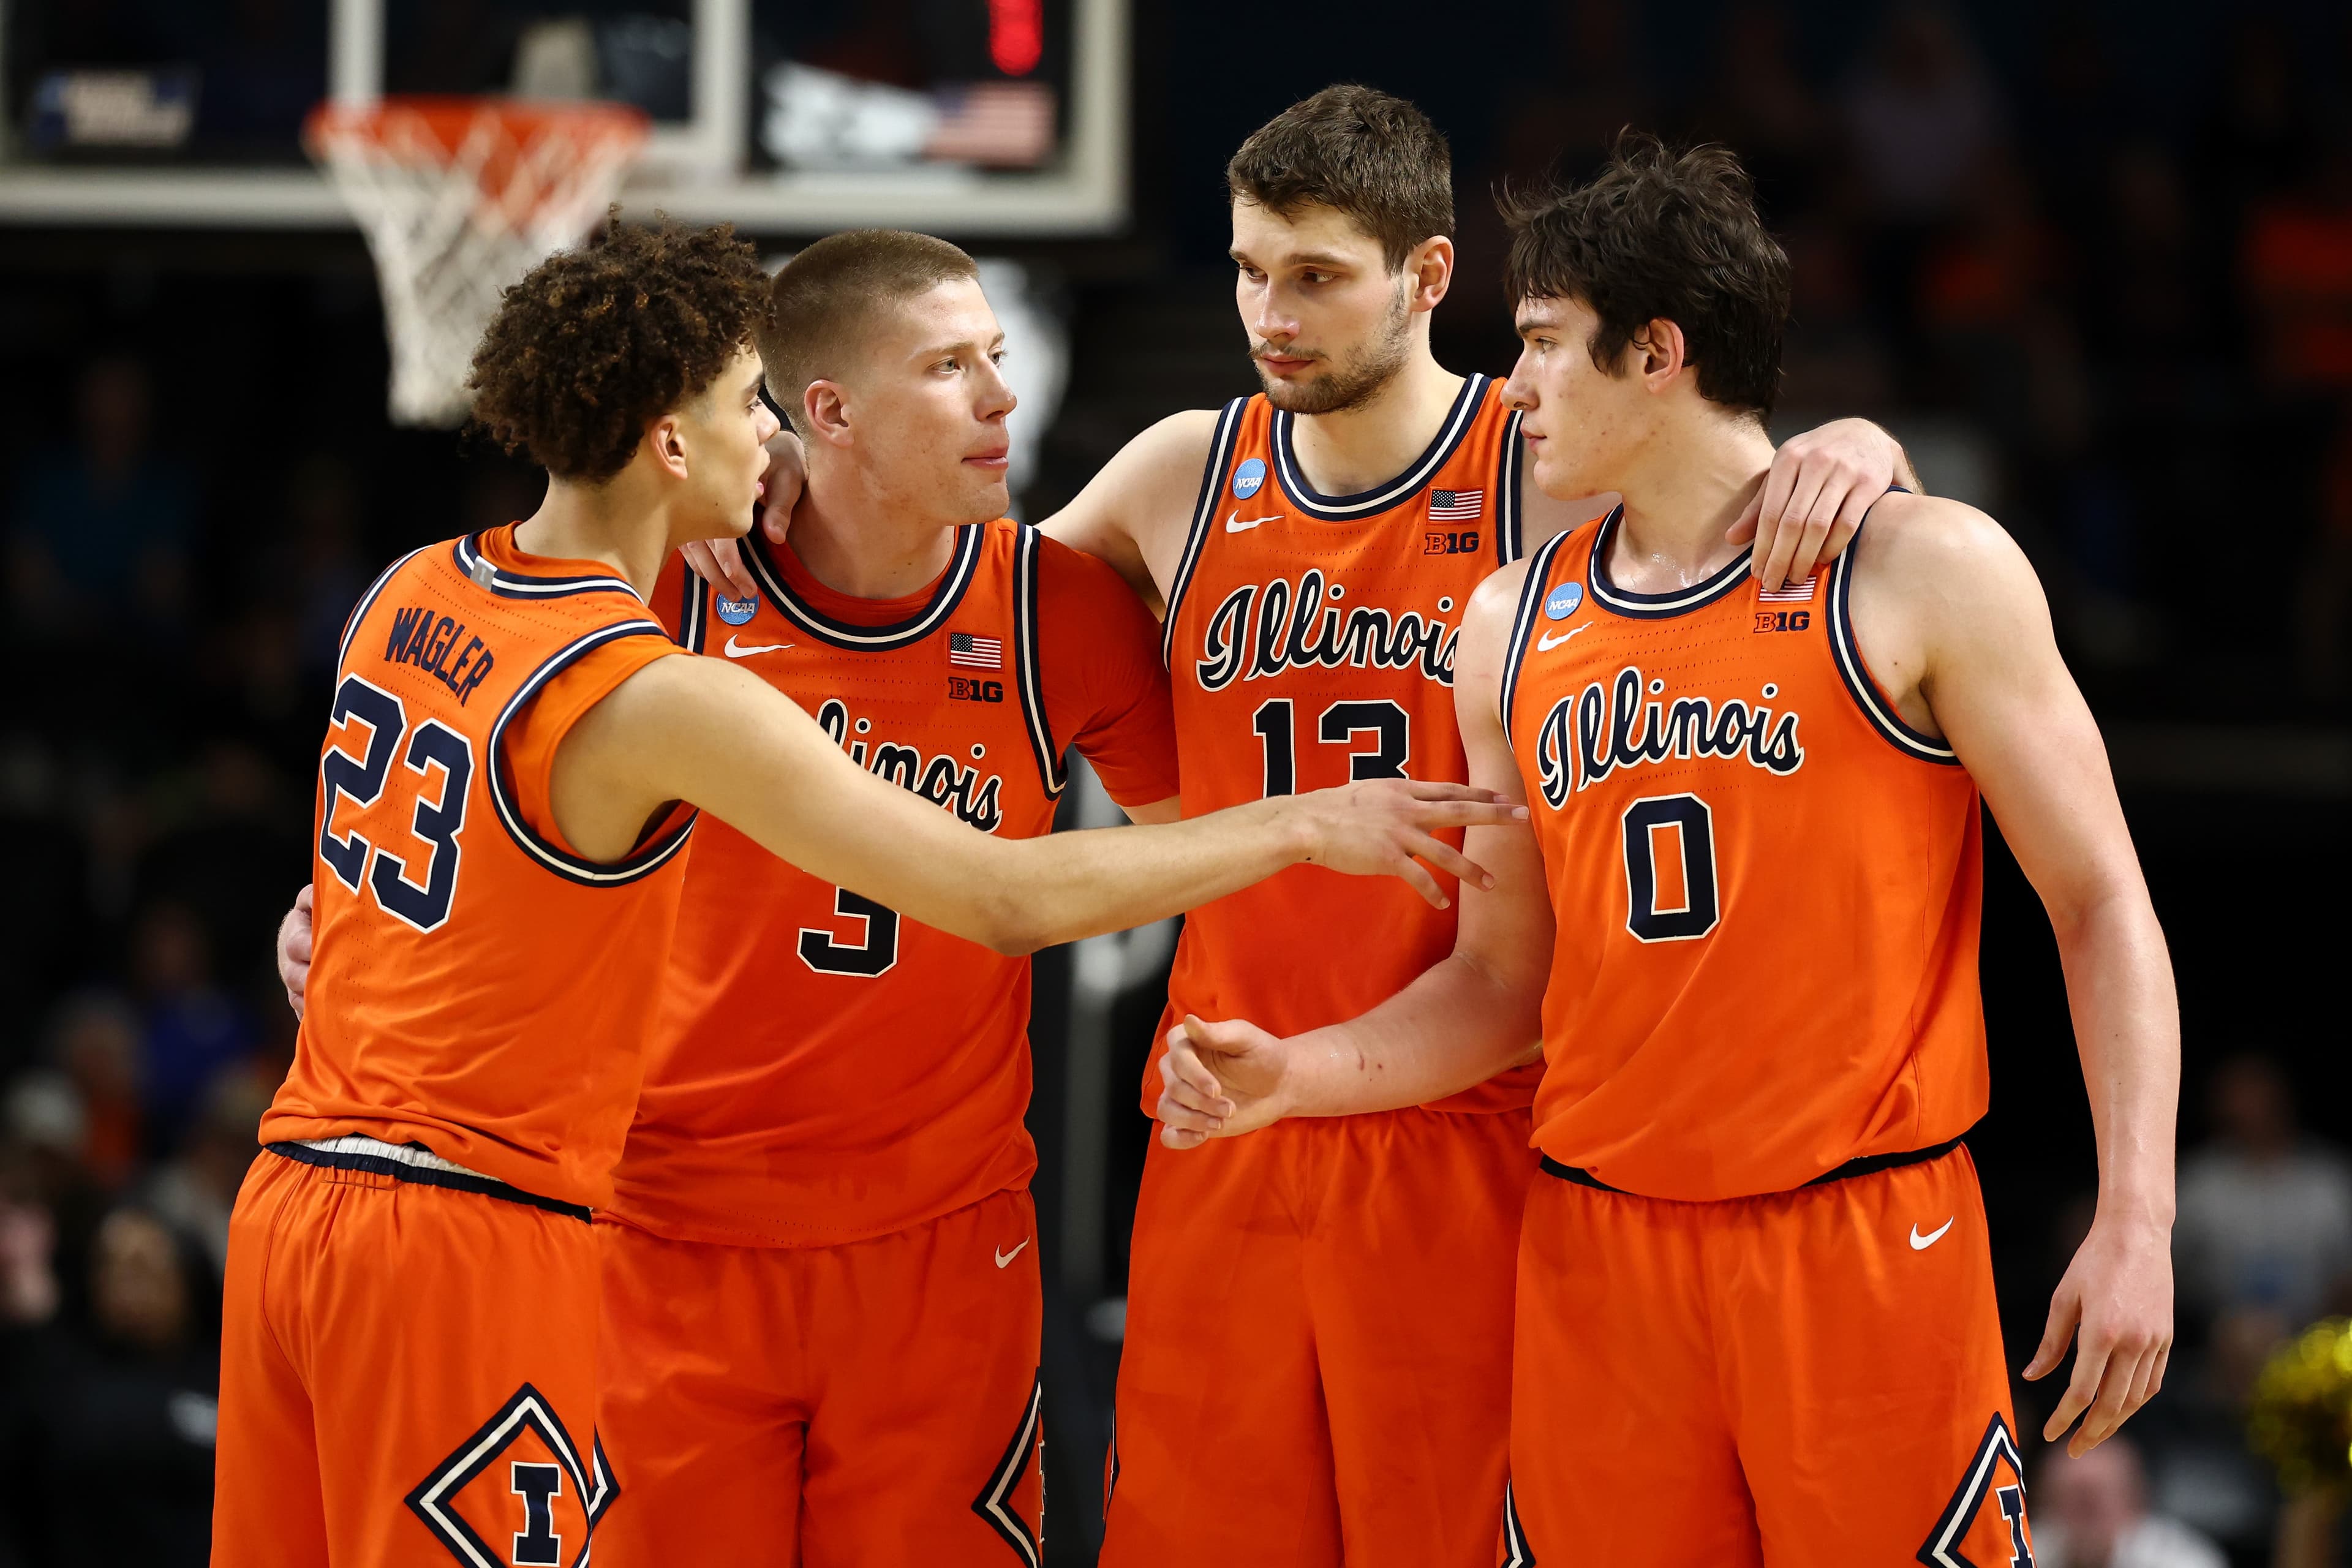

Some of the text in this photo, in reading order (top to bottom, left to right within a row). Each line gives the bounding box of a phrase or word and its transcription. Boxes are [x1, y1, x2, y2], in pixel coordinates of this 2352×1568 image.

[1235, 477, 1262, 489] NCAA
[721, 602, 755, 614] NCAA
[1548, 598, 1578, 611] NCAA
[384, 608, 494, 707] WAGLER
[816, 698, 1003, 834] inois
[1253, 698, 1410, 799] 13
[1537, 666, 1804, 811] Illinois
[321, 672, 475, 934] 23
[1621, 792, 1720, 944] 0
[511, 1461, 561, 1567] I
